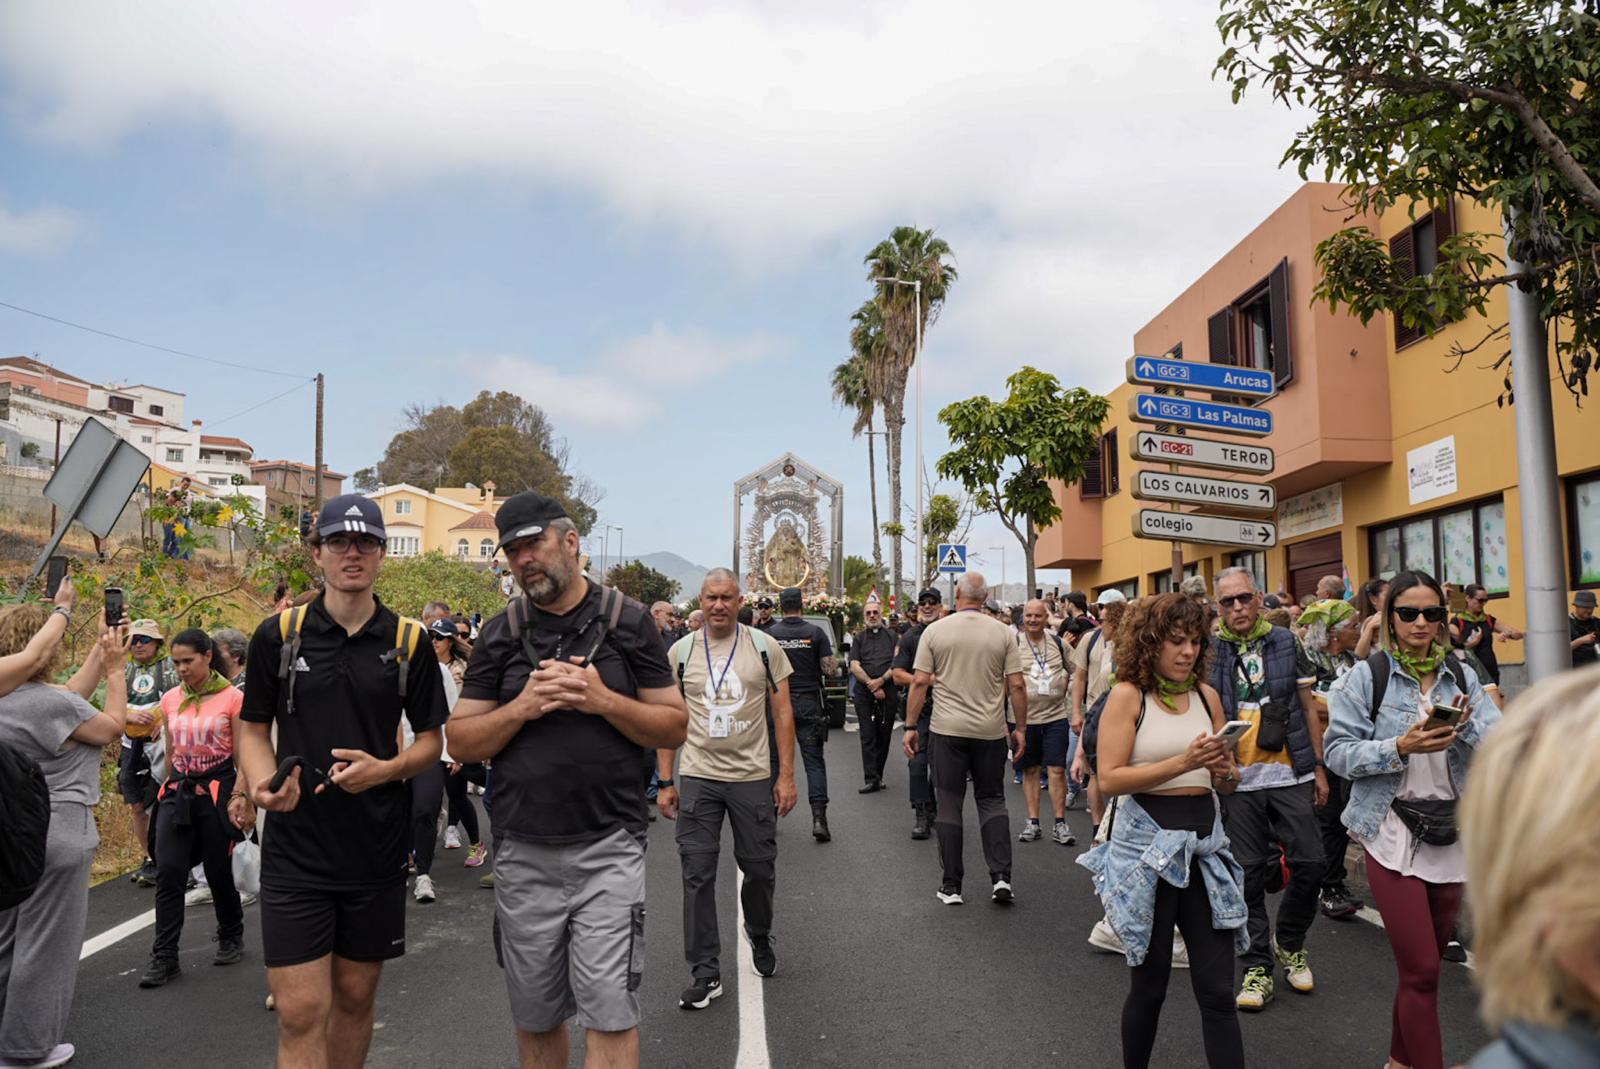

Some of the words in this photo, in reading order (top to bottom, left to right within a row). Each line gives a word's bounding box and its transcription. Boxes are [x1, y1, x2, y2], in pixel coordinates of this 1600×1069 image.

[1159, 366, 1187, 378] GC-3
[1223, 372, 1268, 389] Arucas
[1162, 404, 1189, 416] GC-3
[1197, 407, 1219, 421] Las
[1222, 411, 1268, 428] Palmas
[1162, 442, 1193, 454] GC-21
[1221, 448, 1268, 465] TEROR
[1144, 478, 1170, 491] LOS
[1175, 481, 1249, 500] CALVARIOS
[1145, 516, 1193, 532] colegio
